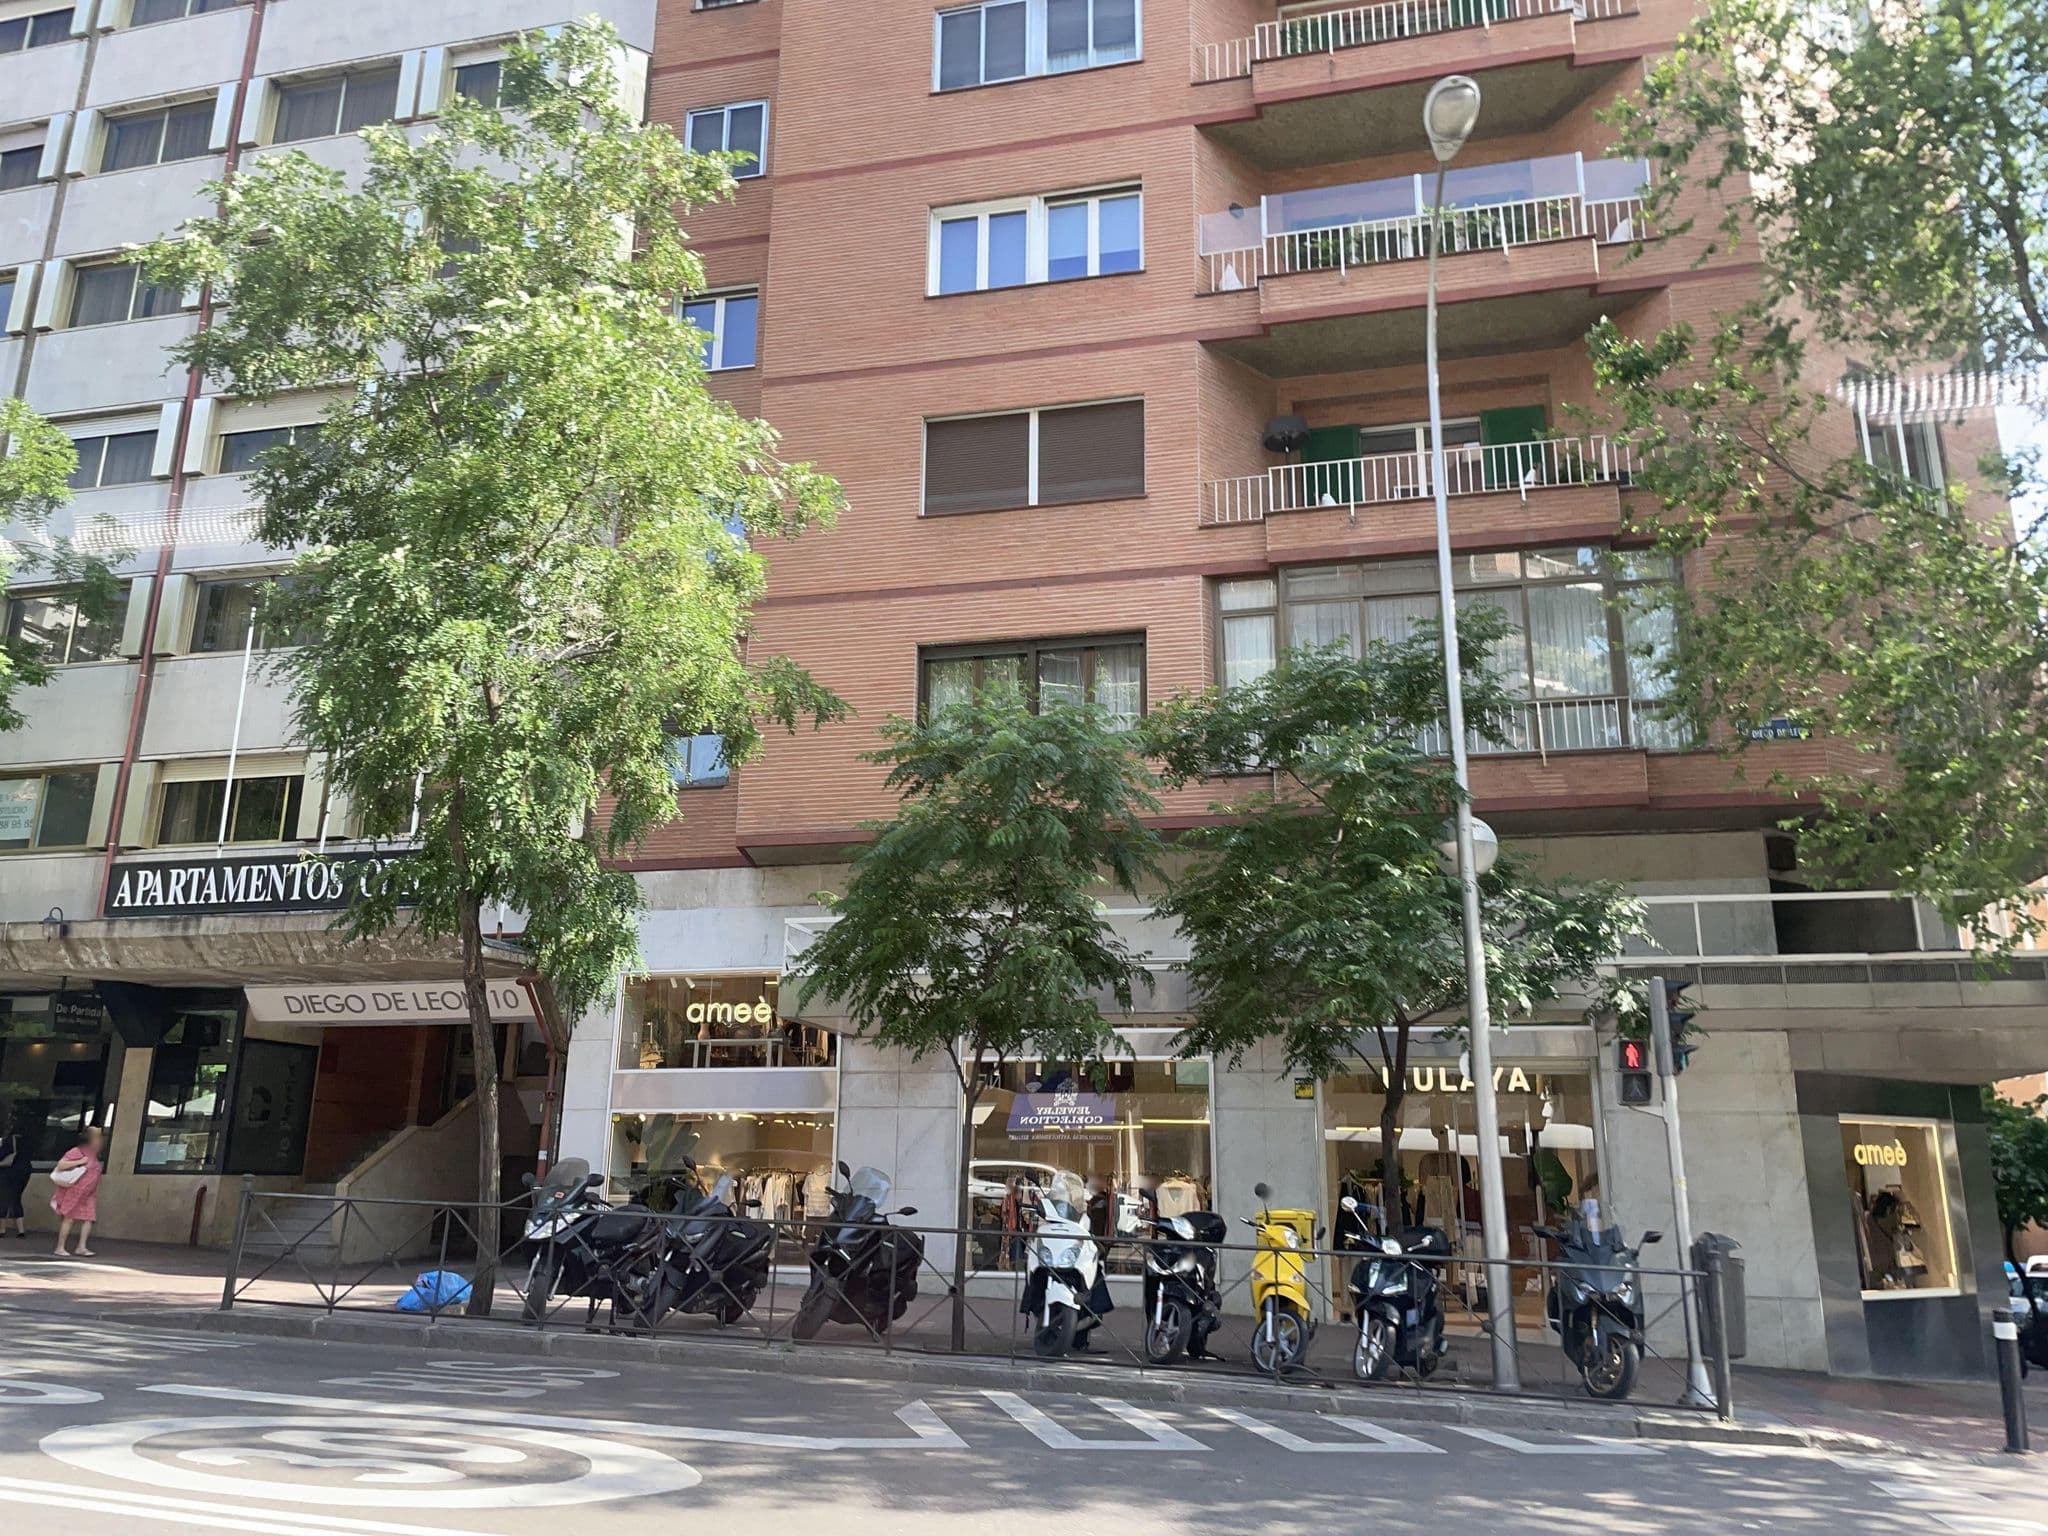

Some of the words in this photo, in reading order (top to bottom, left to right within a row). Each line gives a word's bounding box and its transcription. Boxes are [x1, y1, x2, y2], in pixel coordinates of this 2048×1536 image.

[112, 861, 345, 908] APARTAMENTOS
[284, 994, 366, 1014] DIEGO
[372, 992, 409, 1012] DE
[490, 989, 519, 1009] 10
[319, 1360, 620, 1398] BUS
[176, 1429, 527, 1484] 30
